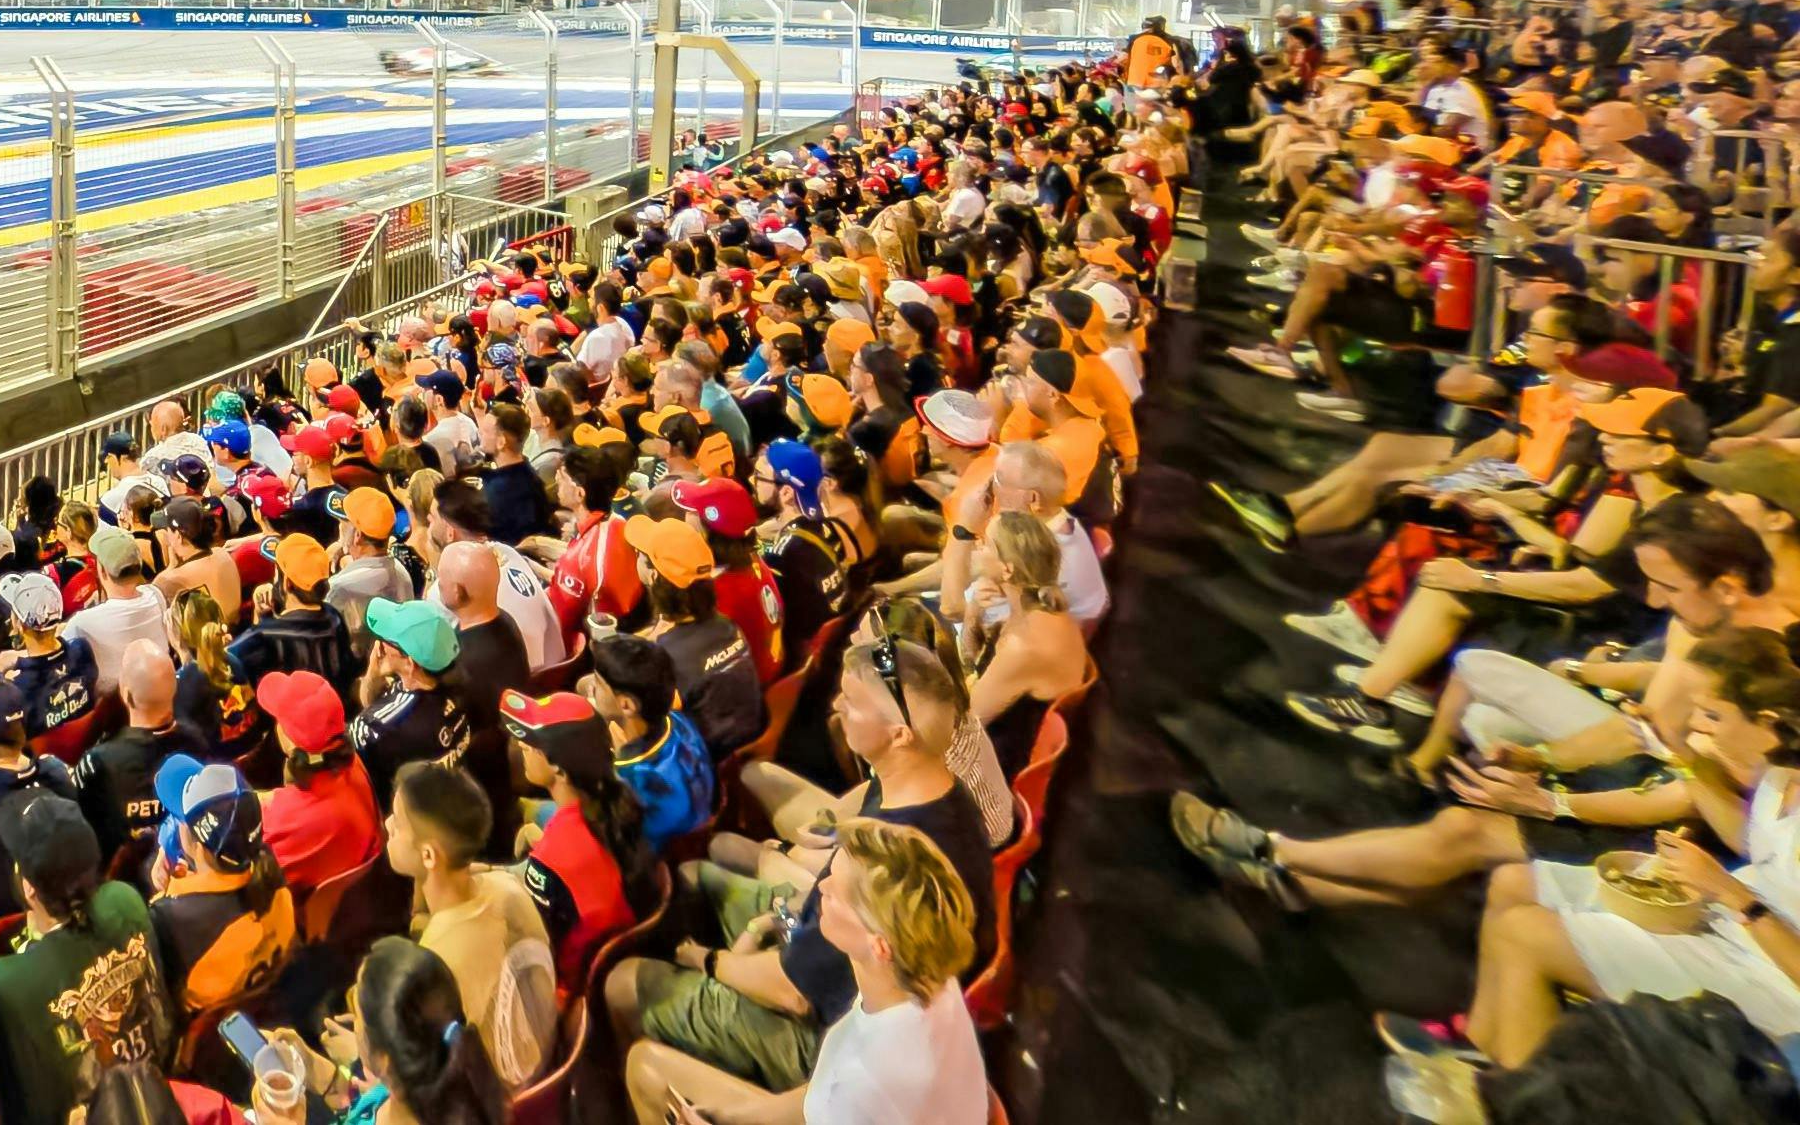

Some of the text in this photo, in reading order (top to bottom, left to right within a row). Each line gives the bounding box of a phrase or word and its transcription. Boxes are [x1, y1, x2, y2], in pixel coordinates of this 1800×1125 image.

[0, 11, 131, 24] SINGAPORE AIRLINES
[175, 12, 302, 24] SINGAPORE AIRLINES
[346, 14, 473, 26] SINGAPORE AIRLINES
[873, 32, 1010, 48] SINGAPORE AIRLINES
[126, 799, 165, 818] PET
